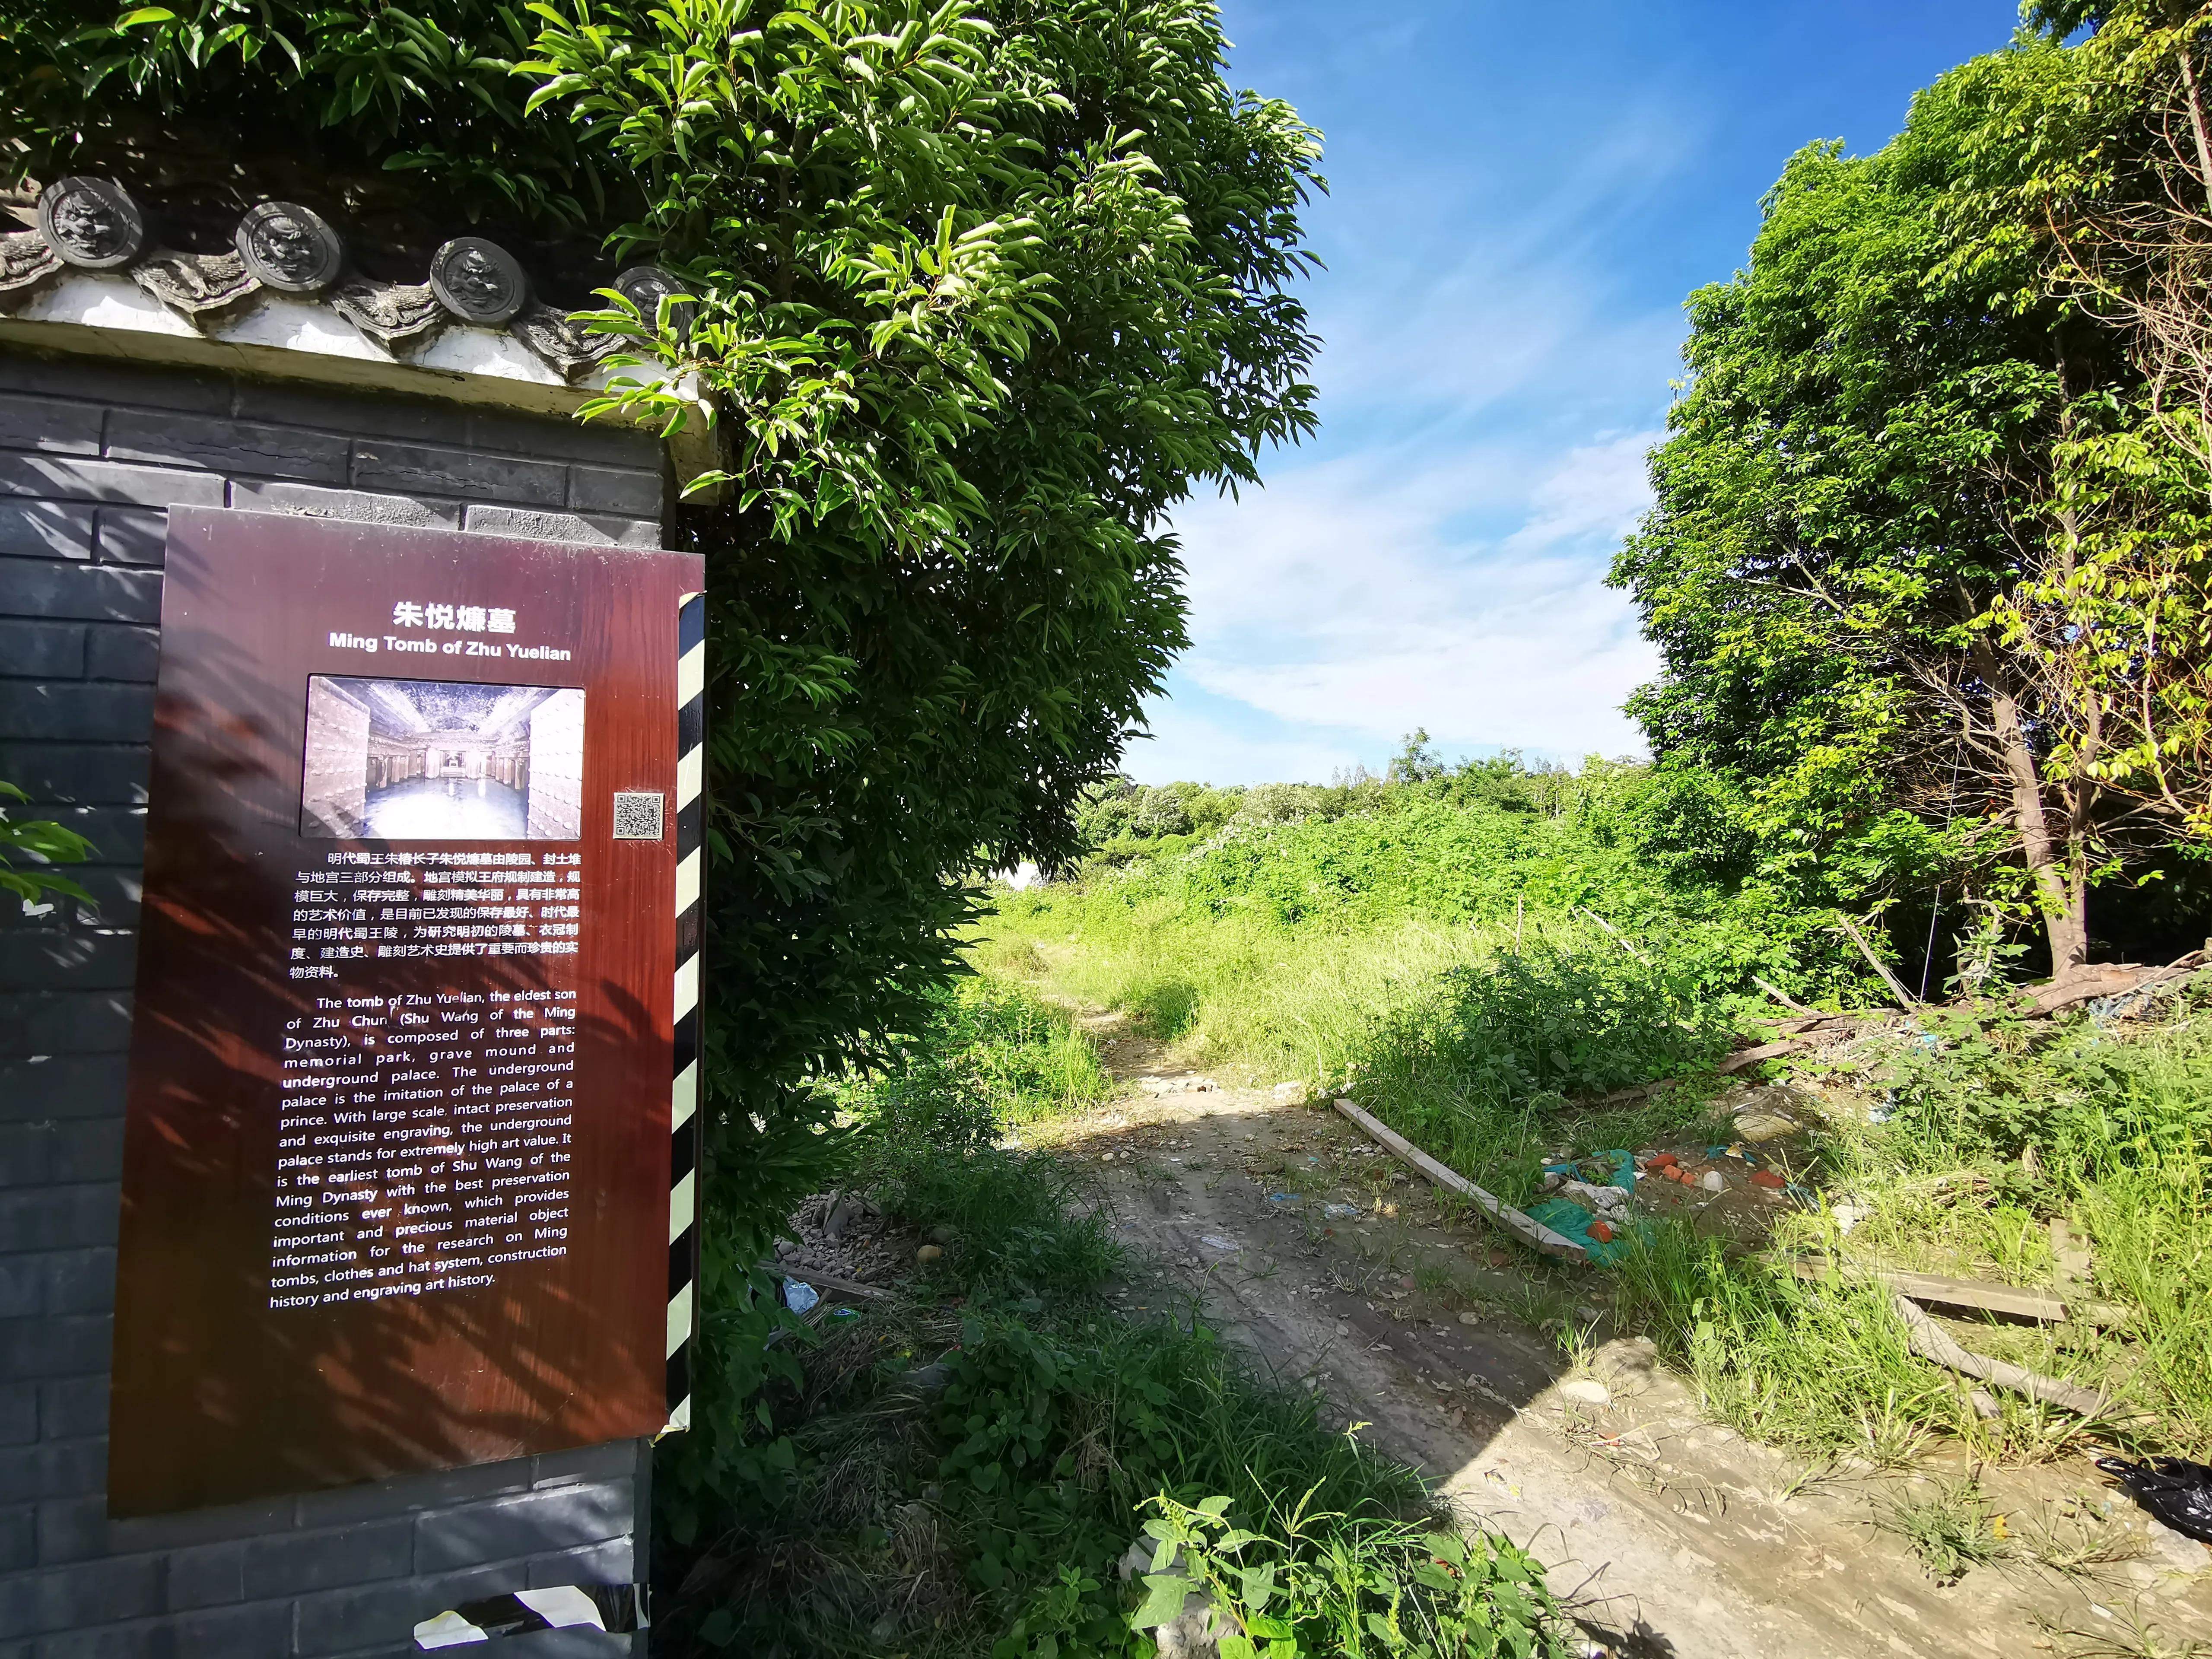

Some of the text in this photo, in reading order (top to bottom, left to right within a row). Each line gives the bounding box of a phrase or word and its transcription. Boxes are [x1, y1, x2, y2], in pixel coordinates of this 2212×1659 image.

[329, 632, 571, 661] Ming Tomb of Zhu Yuelian
[328, 852, 582, 865] 明代蜀王朱椿长子朱悦燫墓由陵园、封土堆
[296, 870, 581, 884] 与地宫三部分组成。地宫模拟王府规制建造，规
[294, 888, 580, 903] 模巨大，保存完整，雕刻精美华丽，具有非常高
[293, 905, 580, 923] 的艺术价值，是目前已发现的保存最好、时代最
[292, 923, 578, 941] 早的明代蜀王陵，为研究明初的陵墓、衣冠制
[290, 941, 578, 960] 度、建造史、雕刻艺术史提供了重要而珍贵的实
[289, 965, 338, 979] 物资料。
[317, 989, 576, 1009] The tomb of Zhu Yuelian, the eldest son
[286, 1006, 575, 1029] of Zhu Chun (Shu Wang of the Ming
[286, 1025, 575, 1051] Dynasty), is composed of three parts:
[284, 1042, 574, 1068] memorial park, grave mound and
[283, 1059, 574, 1089] underground palace. The underground
[282, 1078, 573, 1110] palace is the imitation of the palace of a
[281, 1097, 572, 1130] prince. With large scale, intact preservation
[279, 1114, 572, 1147] and exquisite engraving, the underground
[278, 1133, 572, 1170] palace stands for extremely high art value. It
[277, 1151, 571, 1187] is the earliest tomb of Shu Wang of the
[276, 1170, 569, 1208] Ming Dynasty with the best preservation
[275, 1189, 569, 1227] conditions ever known, which provides
[273, 1207, 569, 1249] important and precious material object
[273, 1227, 567, 1267] information for the research on Ming
[271, 1245, 566, 1288] tombs, clothes and hat system, construction
[270, 1274, 495, 1308] history and engraving art history.
